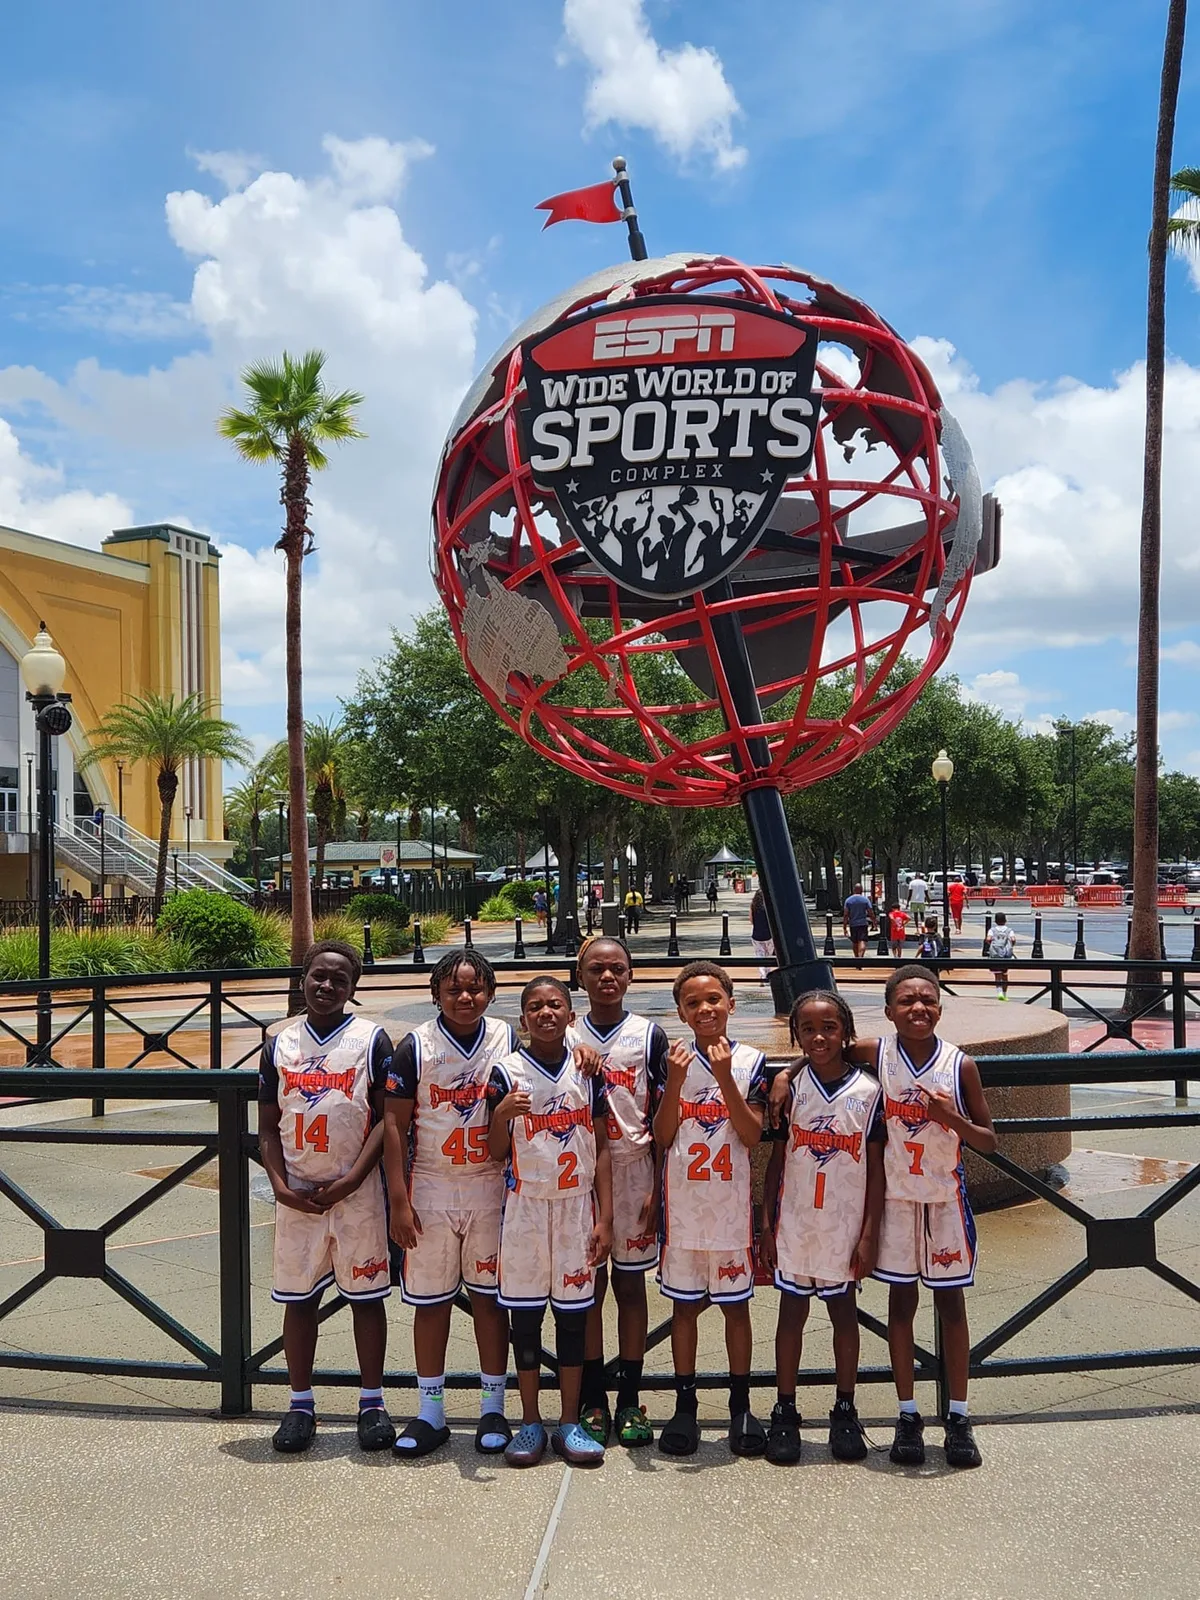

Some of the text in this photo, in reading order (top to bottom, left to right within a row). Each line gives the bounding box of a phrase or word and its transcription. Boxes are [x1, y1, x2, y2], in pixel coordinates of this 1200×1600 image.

[593, 313, 736, 360] ESPN
[541, 366, 797, 409] WIDE WORLD OF
[530, 397, 814, 473] SPORTS
[610, 463, 724, 483] COMPLEX
[477, 614, 501, 658] DRIVE
[339, 1038, 364, 1050] NYC
[295, 1113, 329, 1153] 14
[442, 1125, 490, 1165] 45
[558, 1151, 579, 1190] 2
[687, 1143, 733, 1181] 24
[904, 1141, 925, 1176] 7
[814, 1172, 826, 1209] 1
